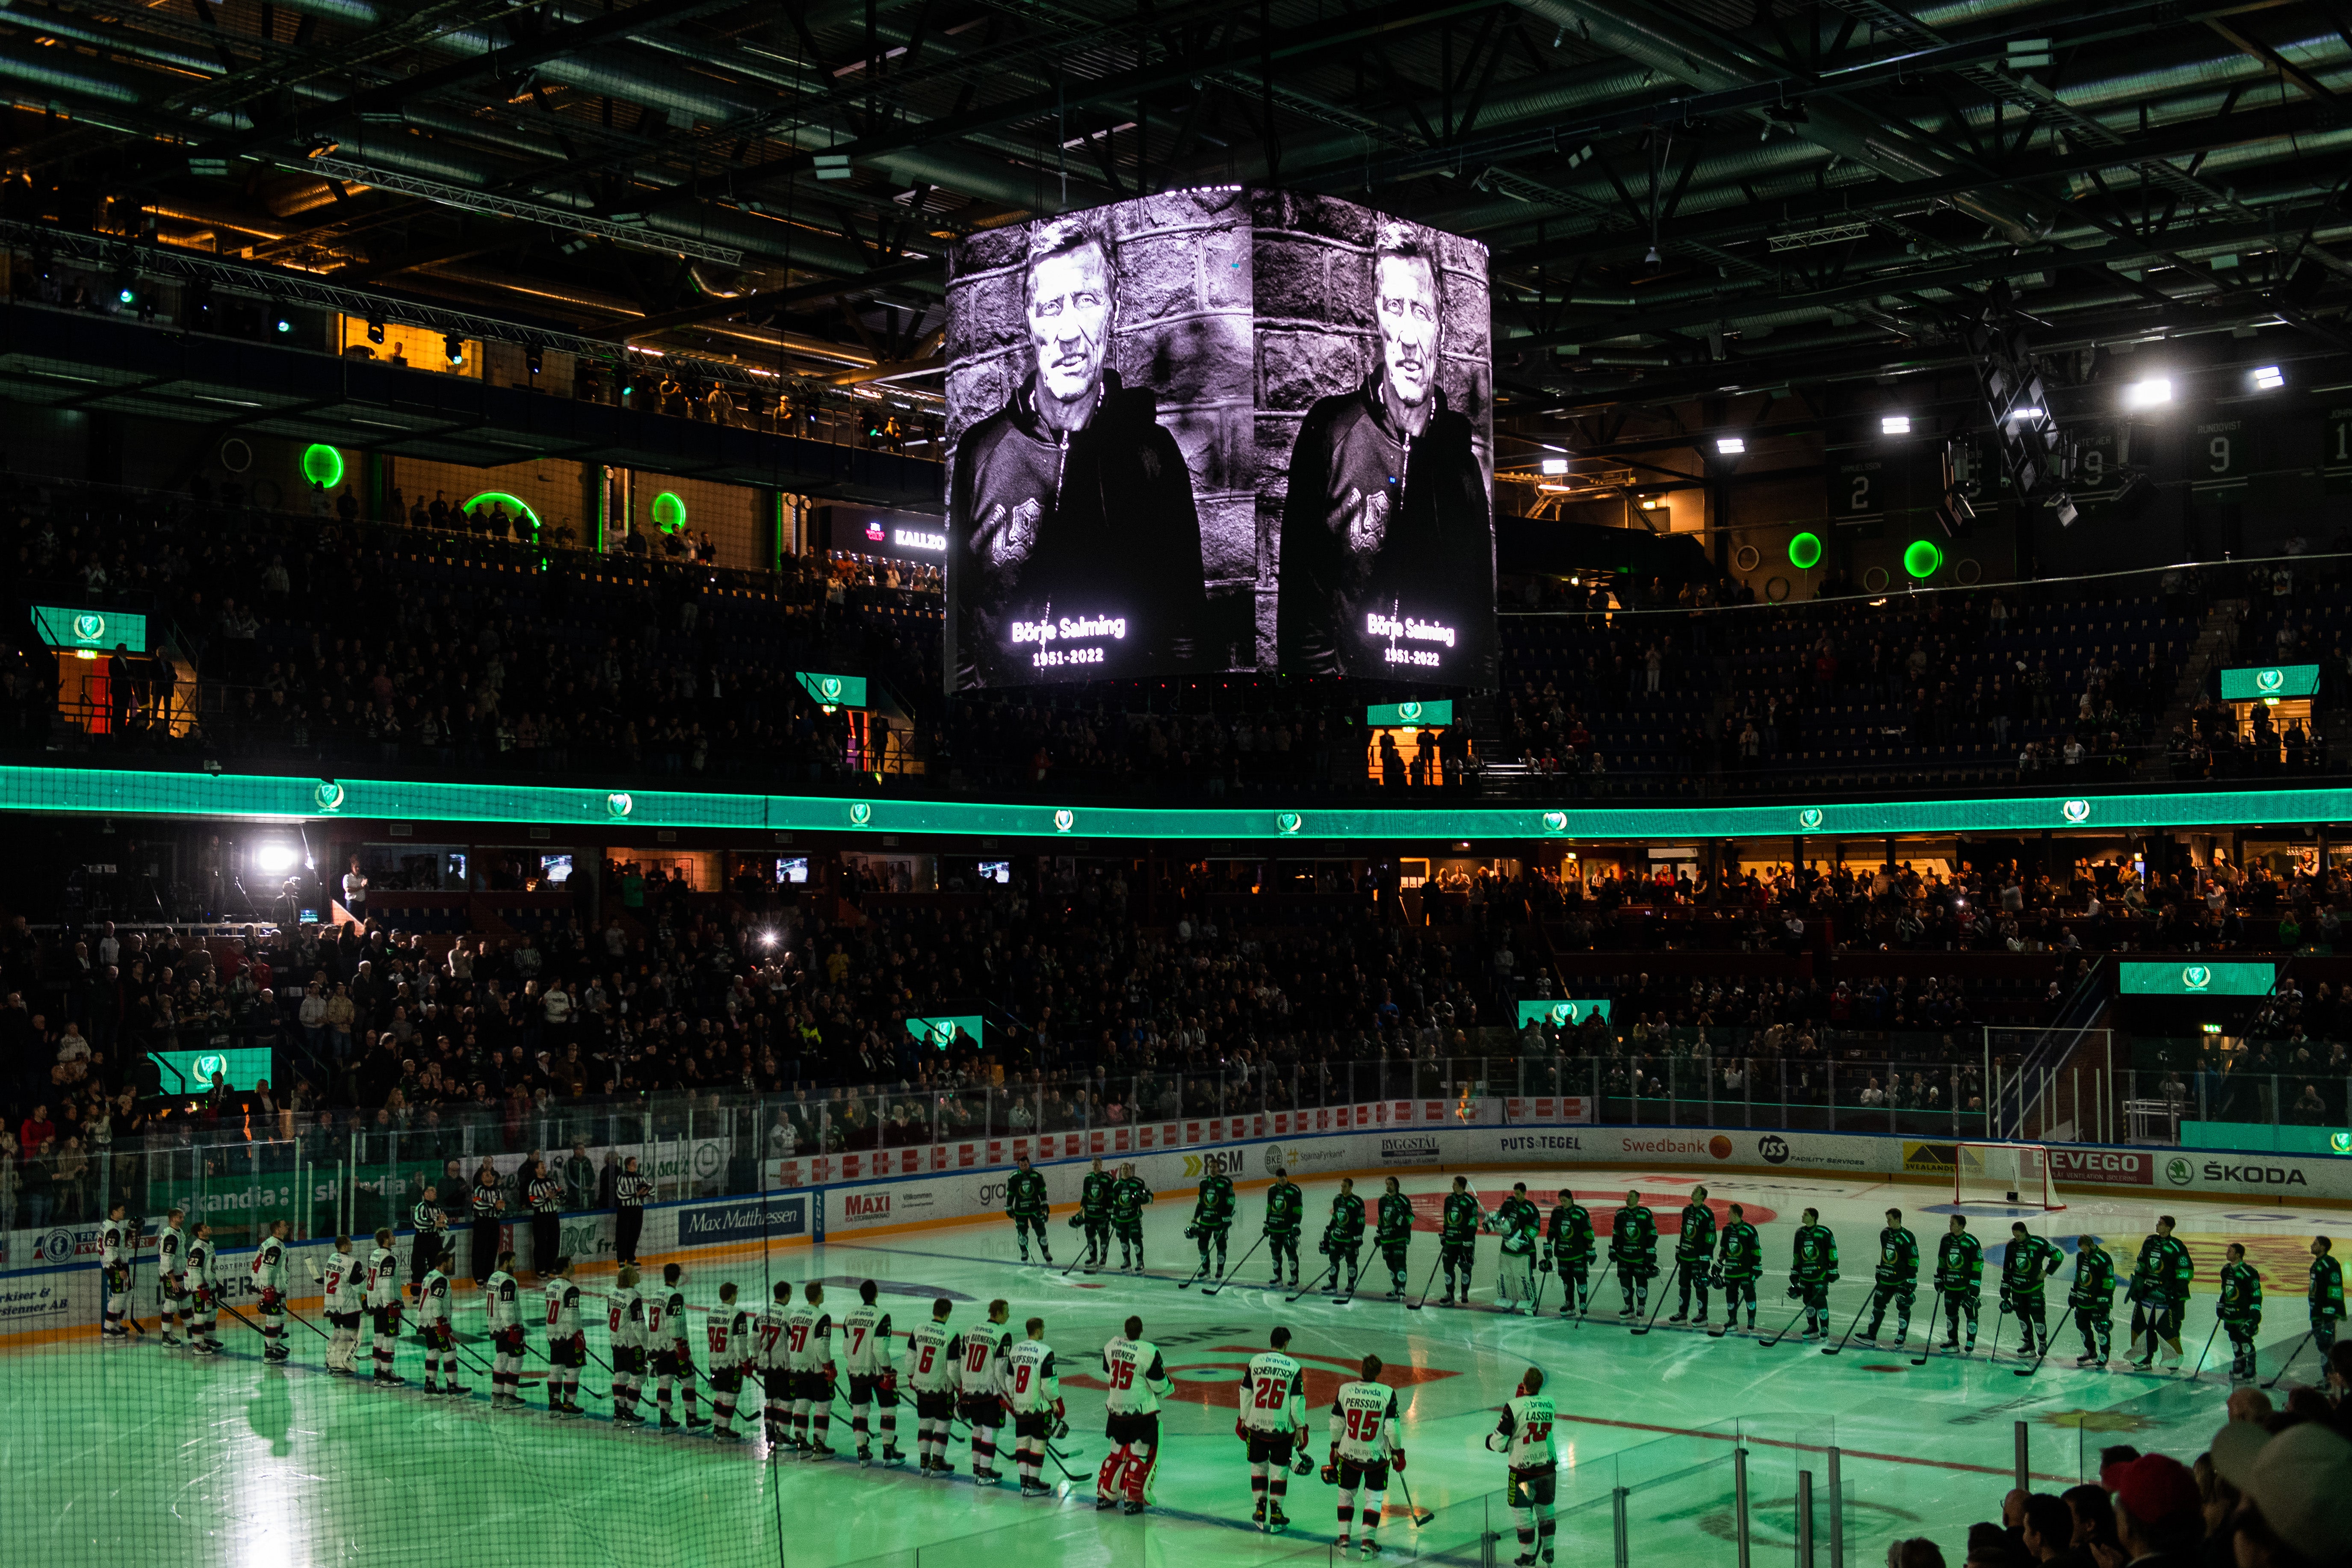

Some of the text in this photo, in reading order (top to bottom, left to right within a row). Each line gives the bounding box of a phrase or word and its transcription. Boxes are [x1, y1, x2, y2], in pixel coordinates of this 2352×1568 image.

[2210, 437, 2230, 472] 9
[2084, 451, 2103, 485] 9
[1852, 475, 1869, 509] 2
[1012, 614, 1125, 645] Börje Salming
[1368, 613, 1454, 647] Börje Salming
[1033, 648, 1103, 666] 1951-2022
[1385, 648, 1439, 666] 1951-2022
[1382, 1134, 1439, 1149] BYGGSTÅL
[1501, 1137, 1534, 1151] PUTS
[1540, 1136, 1581, 1150] TEGEL
[1622, 1138, 1706, 1153] Swedbank
[1267, 1156, 1281, 1165] BKE
[2033, 1150, 2139, 1172] BEVEGO
[2204, 1161, 2308, 1186] ŠKODA
[845, 1195, 890, 1216] MAXI
[688, 1208, 797, 1233] Max Matthiessen
[382, 1267, 393, 1276] 29
[433, 1287, 444, 1296] 47
[672, 1305, 681, 1315] 73
[853, 1328, 866, 1355] 7
[916, 1335, 946, 1347] JOHNSSON
[919, 1346, 936, 1373] 6
[966, 1344, 988, 1372] 10
[1111, 1349, 1135, 1361] WERNER
[1265, 1356, 1291, 1367] bravida
[1016, 1365, 1031, 1394] 8
[1110, 1359, 1136, 1390] 35
[1253, 1366, 1295, 1379] SCHEMITSCH
[1255, 1378, 1287, 1409] 26
[1354, 1387, 1381, 1397] bravida
[1345, 1397, 1382, 1409] PERSSON
[1347, 1409, 1383, 1441] 95
[1526, 1411, 1553, 1421] LASSEN
